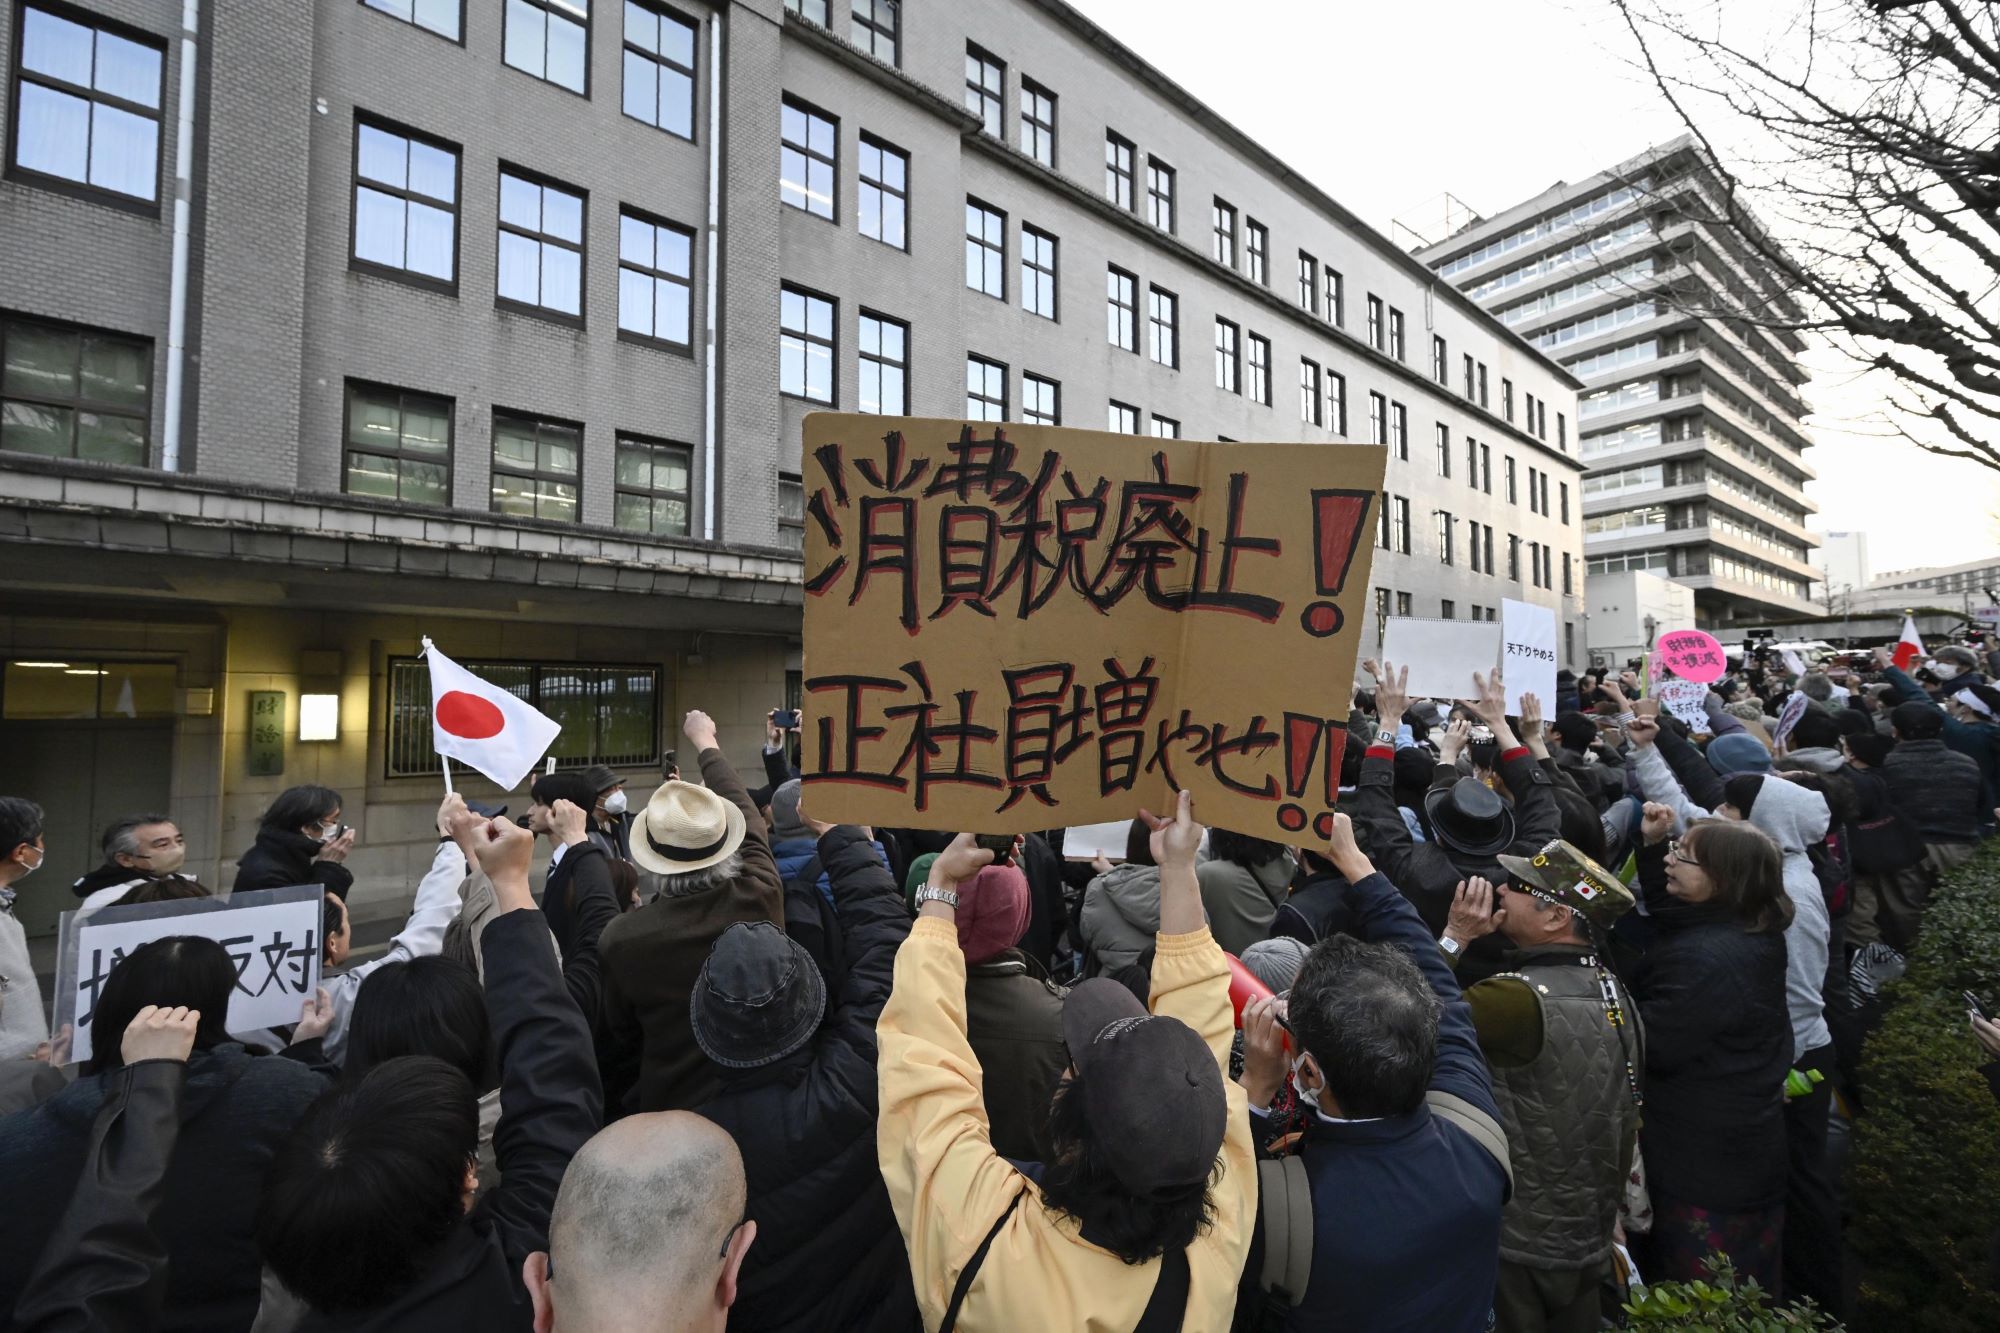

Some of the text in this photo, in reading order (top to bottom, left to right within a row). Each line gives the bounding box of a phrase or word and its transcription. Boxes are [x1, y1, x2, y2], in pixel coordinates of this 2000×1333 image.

[803, 424, 1375, 638] 消費税廃止!
[1506, 642, 1555, 662] 天下りやめろ
[1583, 876, 1603, 893] UFO
[1531, 888, 1551, 902] UFO
